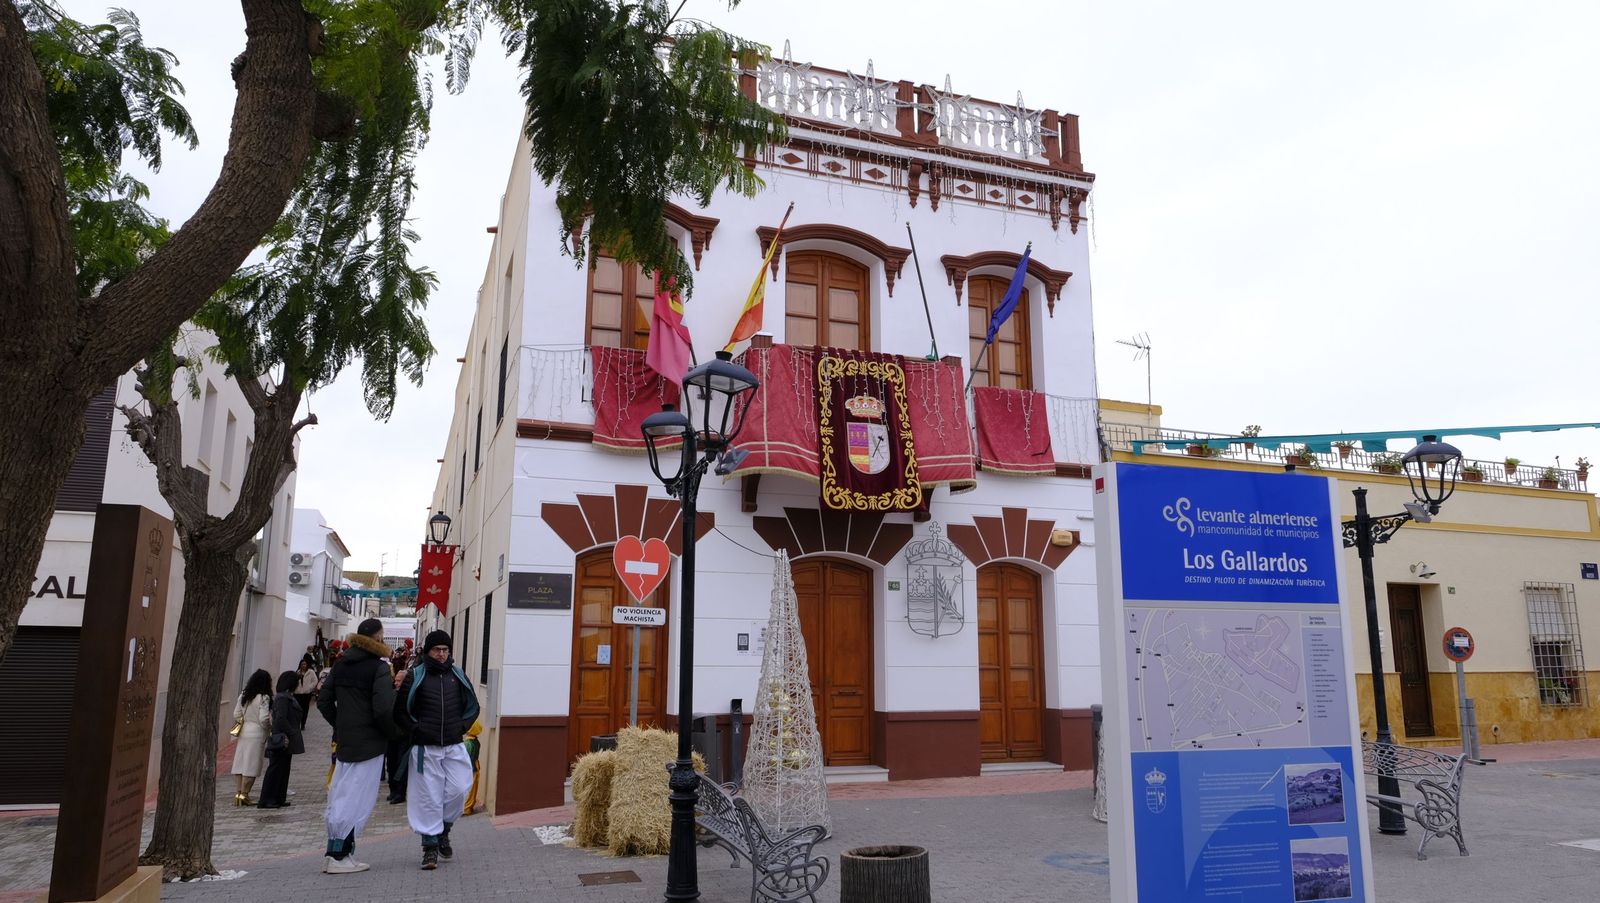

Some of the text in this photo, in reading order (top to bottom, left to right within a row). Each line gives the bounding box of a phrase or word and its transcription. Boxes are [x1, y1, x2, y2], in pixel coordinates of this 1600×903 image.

[1196, 507, 1319, 527] levante almeriense
[1197, 525, 1320, 541] mancomunidad de municipios
[1183, 548, 1308, 573] Los Gallardos
[28, 575, 87, 599] AL
[1184, 575, 1326, 587] DESTINO PILOTO DE DINAMIZACIÓN TURÍSTICA
[527, 586, 554, 594] PLAZA
[623, 615, 655, 623] MACHISTA
[629, 608, 662, 616] VIOLENCIA
